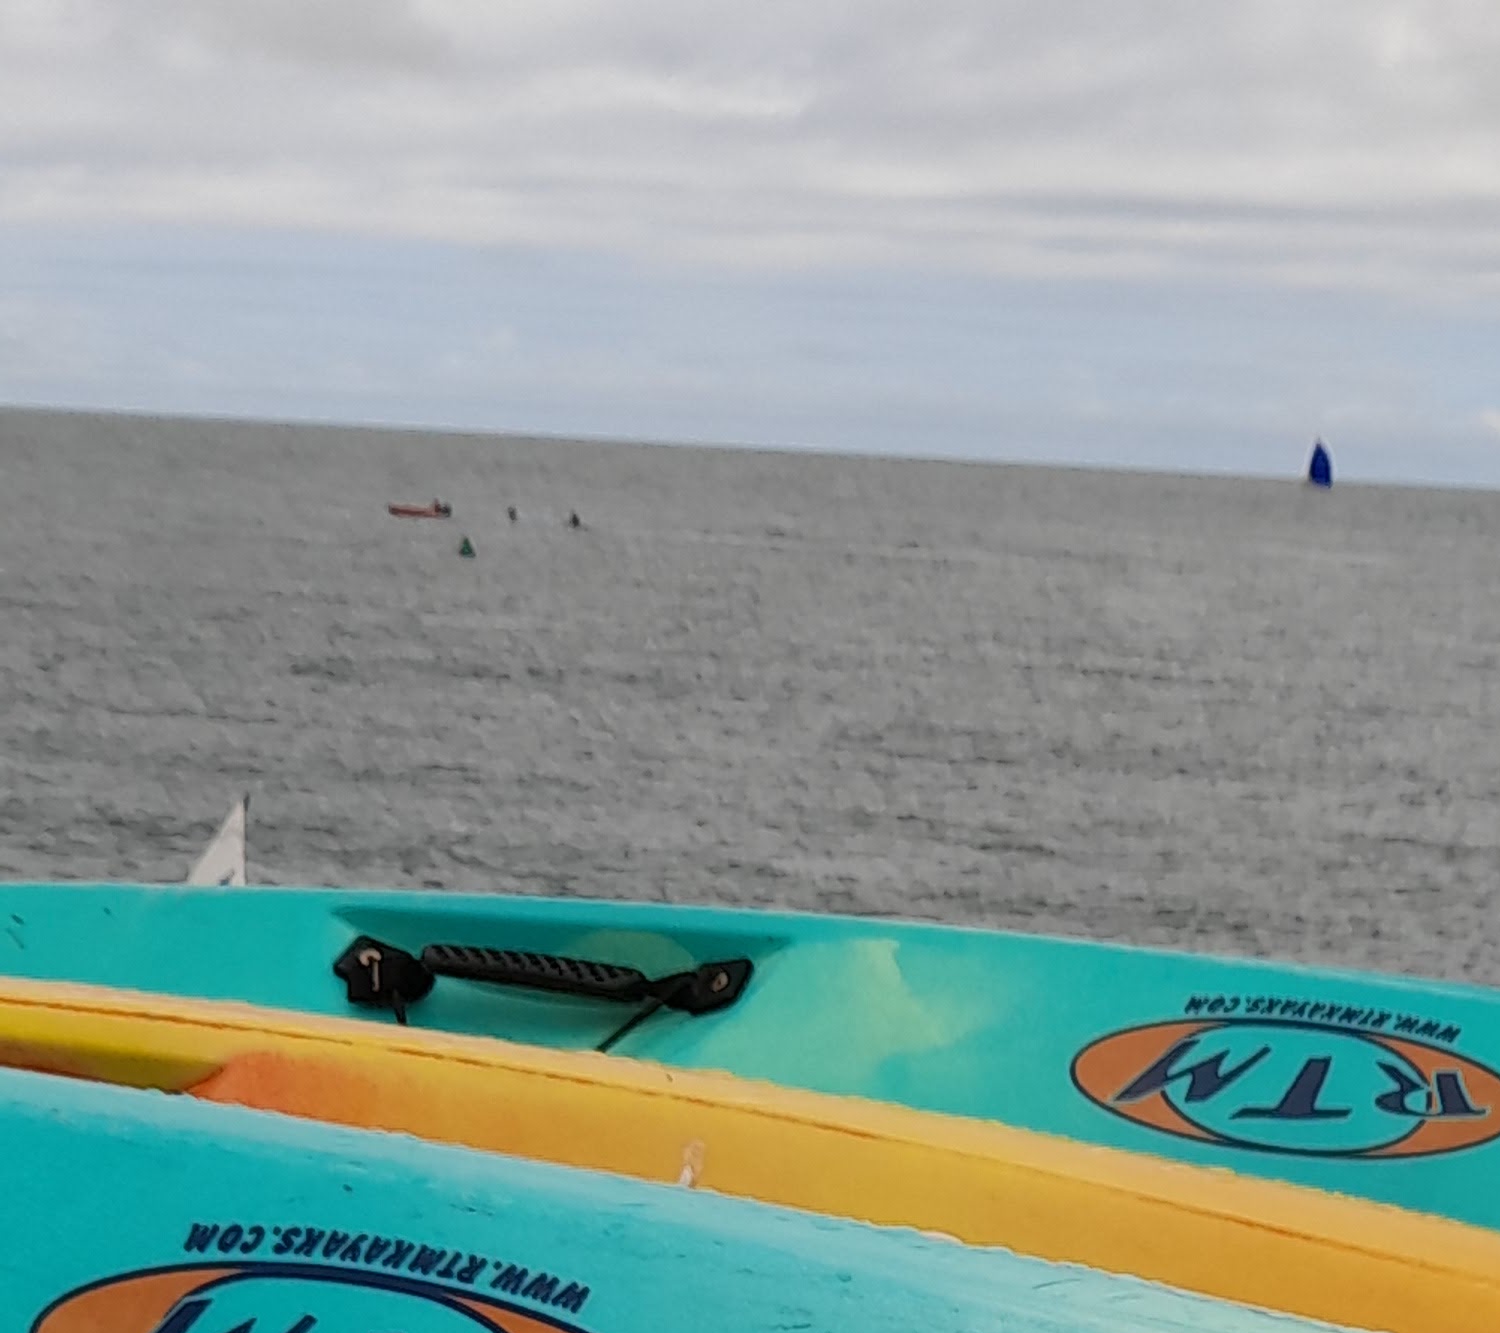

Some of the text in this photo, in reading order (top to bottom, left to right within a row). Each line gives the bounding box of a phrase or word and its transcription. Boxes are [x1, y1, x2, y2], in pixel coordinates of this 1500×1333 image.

[1185, 996, 1461, 1044] WWW.RTMKAYAKS.COM
[1113, 1040, 1487, 1119] RTM
[184, 1223, 591, 1313] WWW.RTMKAYAKS.COM
